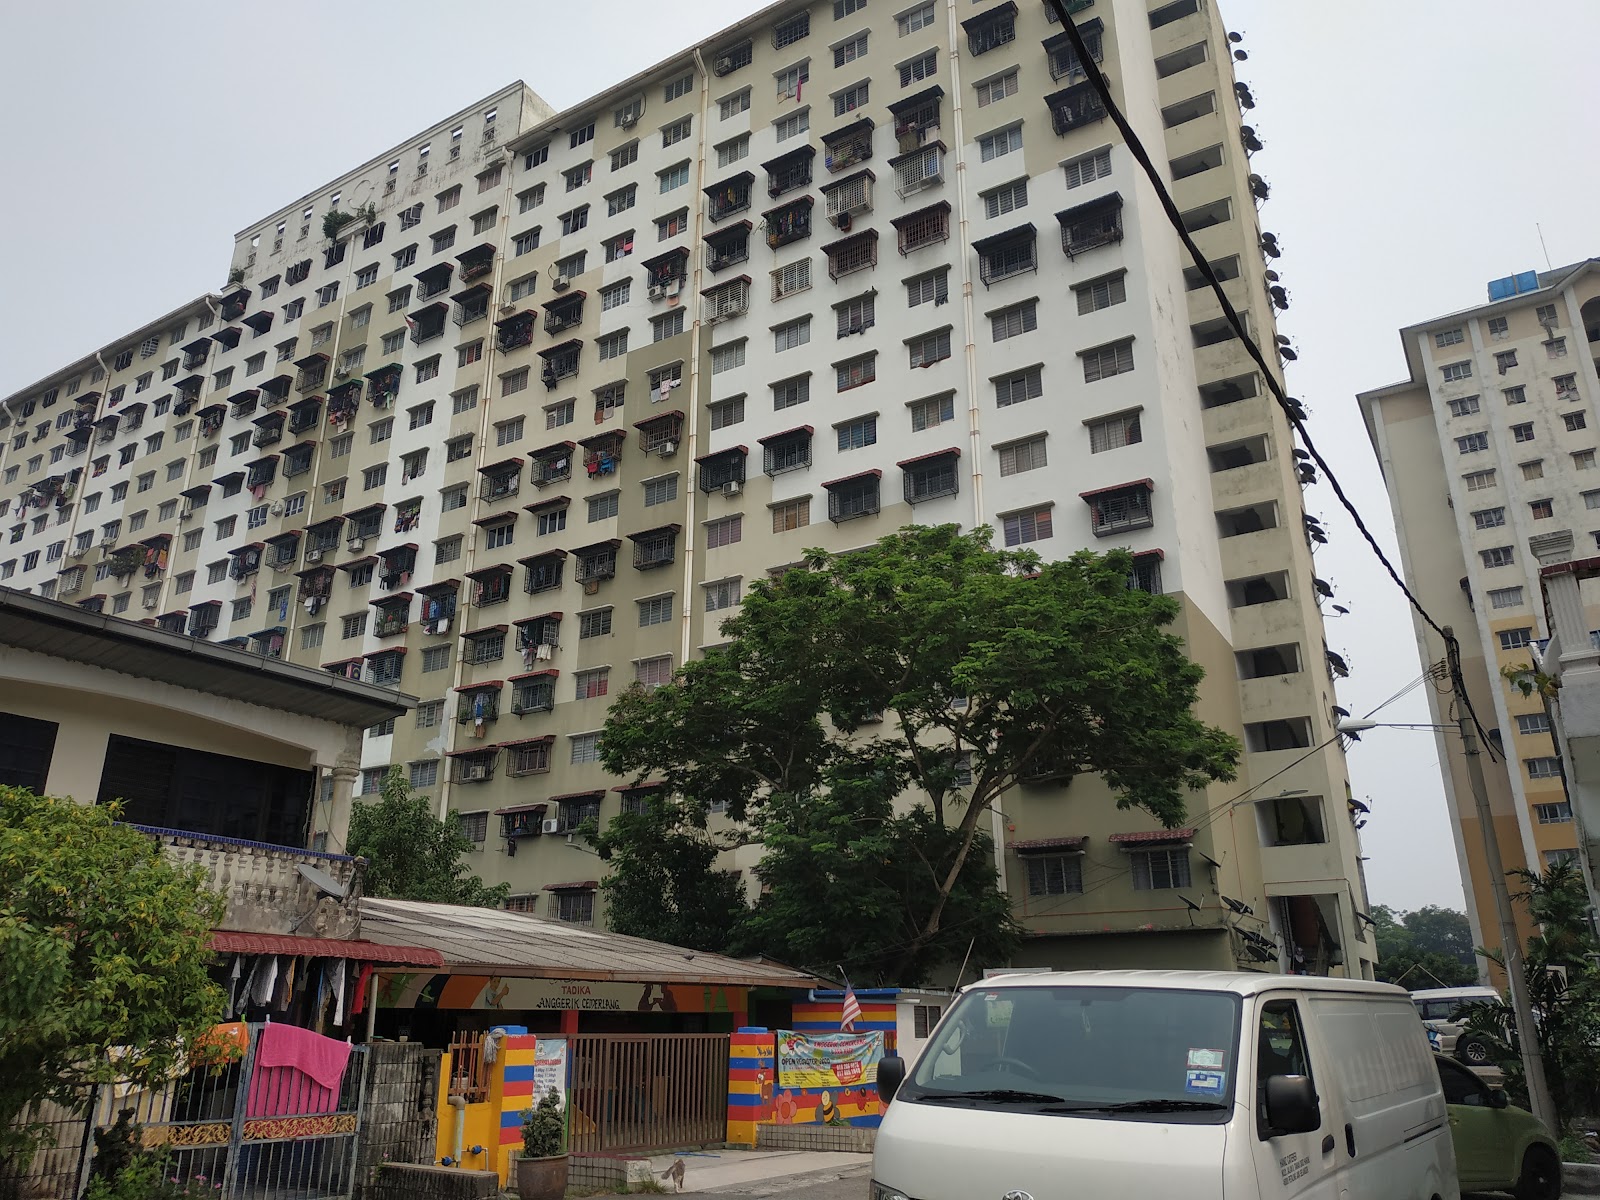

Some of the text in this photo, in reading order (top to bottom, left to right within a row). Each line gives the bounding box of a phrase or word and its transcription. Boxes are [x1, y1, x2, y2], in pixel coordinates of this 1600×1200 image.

[561, 985, 591, 995] TADIKA
[536, 997, 580, 1009] ANGGERIK
[781, 1057, 795, 1065] OPEN
